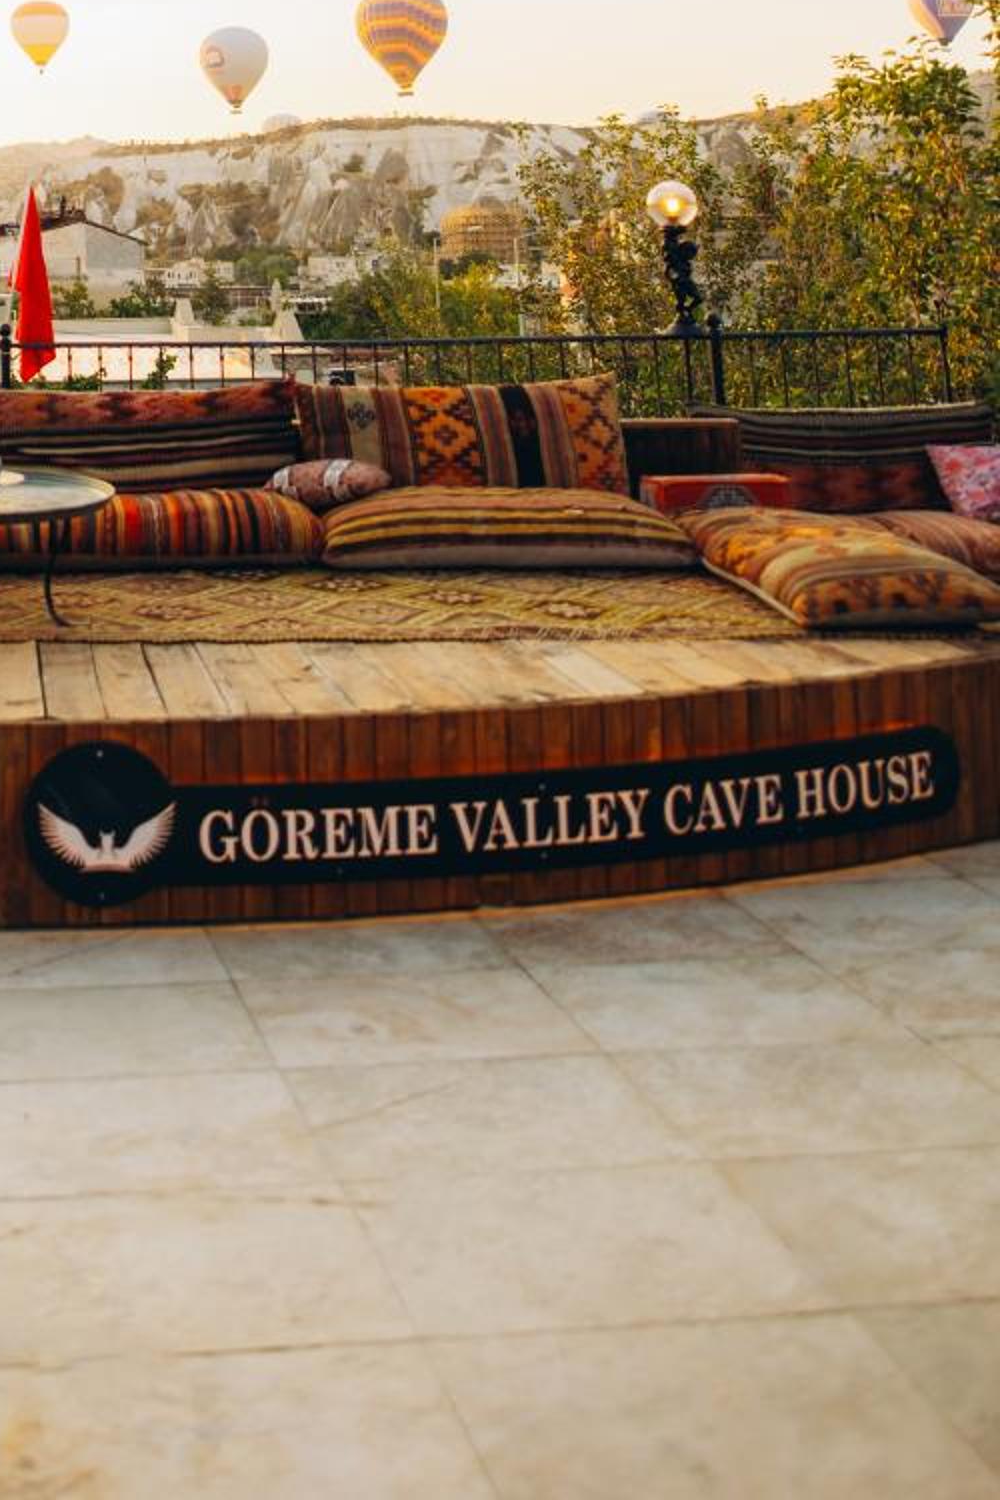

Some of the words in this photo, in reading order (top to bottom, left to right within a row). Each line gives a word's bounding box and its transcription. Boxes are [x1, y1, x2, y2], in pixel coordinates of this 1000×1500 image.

[450, 787, 649, 853] VALLEY
[663, 772, 784, 836] CAVE
[794, 750, 935, 820] HOUSE
